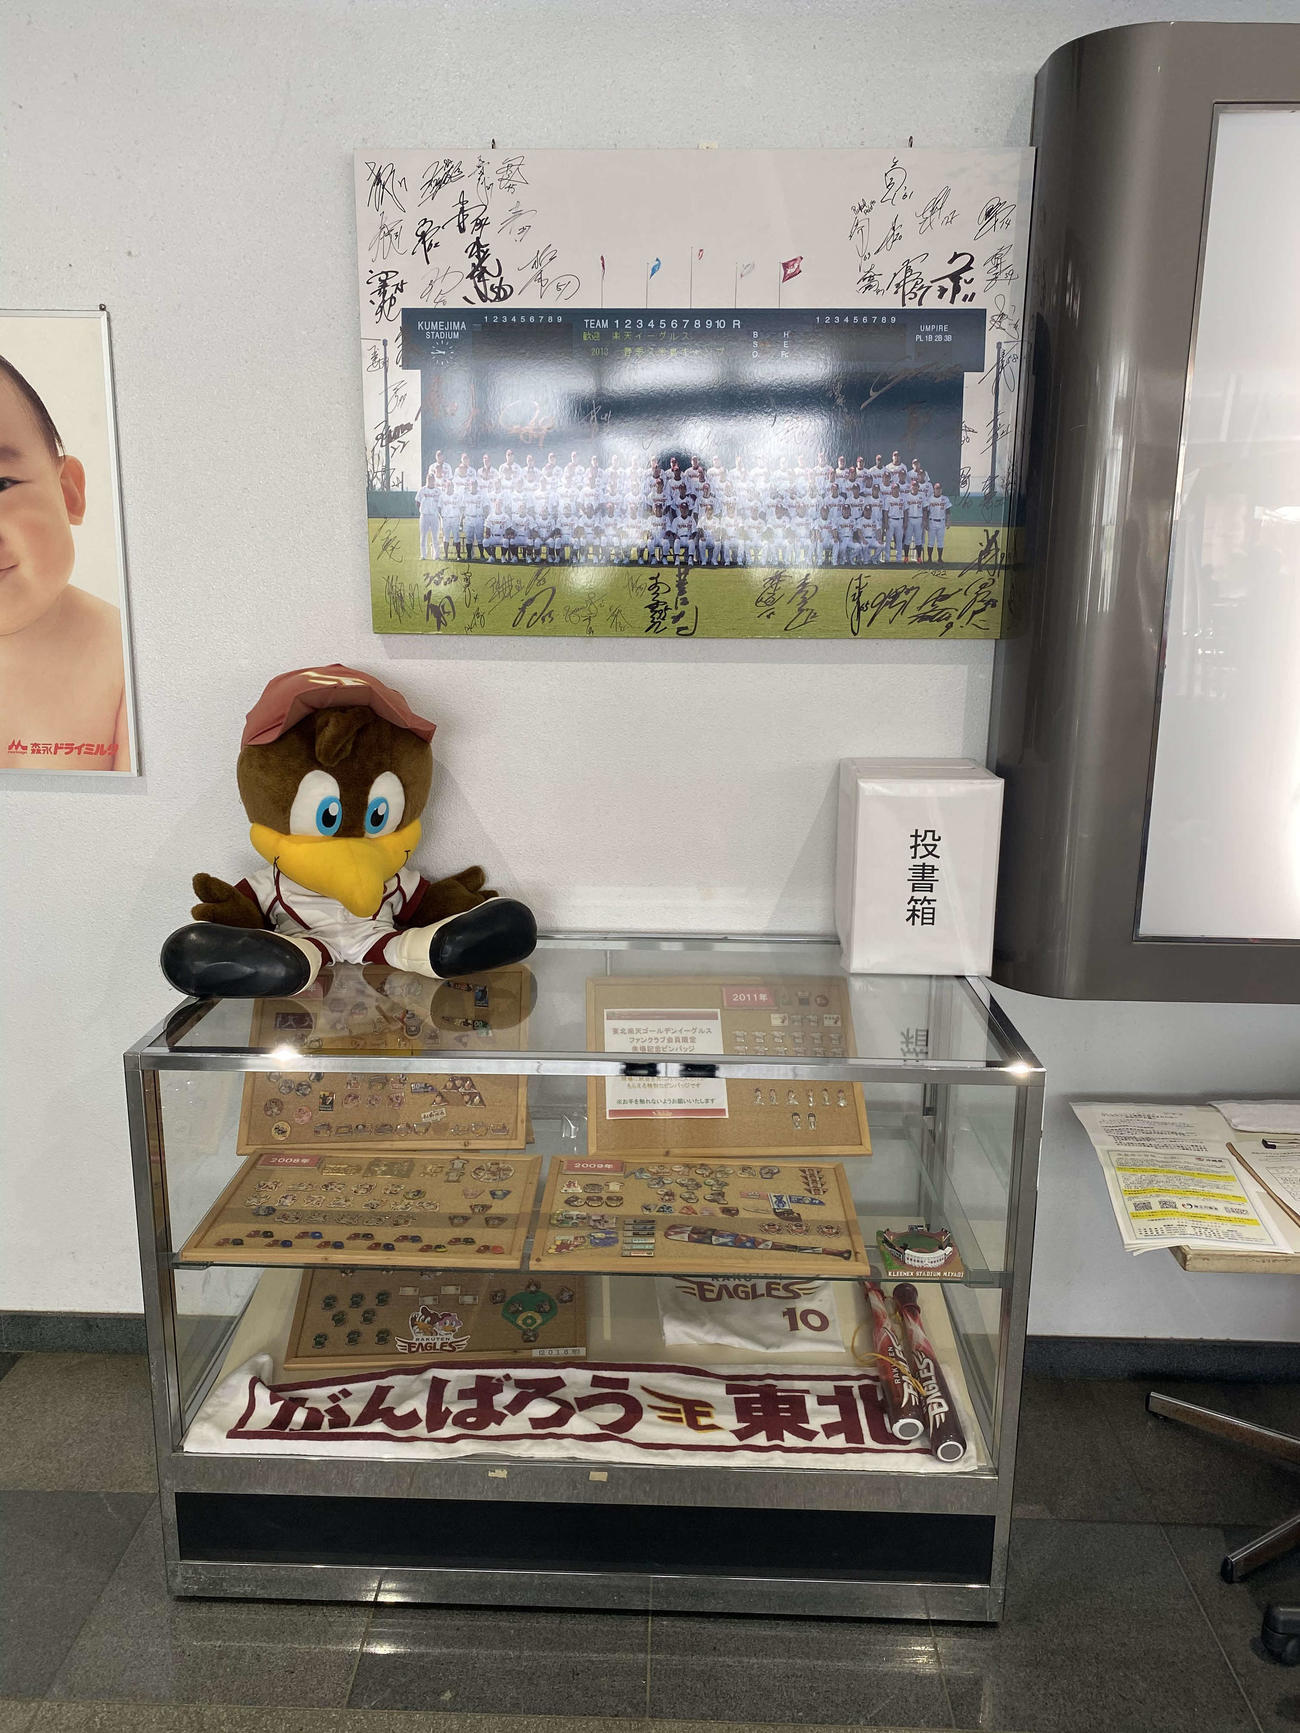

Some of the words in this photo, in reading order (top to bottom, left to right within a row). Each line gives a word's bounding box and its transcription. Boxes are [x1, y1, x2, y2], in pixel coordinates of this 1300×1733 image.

[417, 321, 467, 331] KUMEJIMA
[584, 319, 609, 329] TEAM
[714, 319, 726, 329] 10
[732, 319, 741, 329] R
[920, 324, 949, 332] UMPIRE
[425, 331, 460, 340] STADIUM
[783, 331, 789, 339] H
[915, 334, 924, 342] PL
[752, 340, 758, 348] S
[783, 340, 789, 348] E
[30, 742, 120, 756] 森永ドライミルク
[905, 828, 942, 927] 投書箱
[732, 993, 768, 1001] 2011年
[628, 1036, 697, 1044] ファンクラブ会員限定
[888, 1270, 914, 1278] KLEENEX
[693, 1280, 804, 1303] EAGLES
[782, 1306, 830, 1332] 10
[406, 1341, 458, 1353] EAGLES
[887, 1346, 901, 1385] RAKEN
[915, 1355, 949, 1420] EAGLES
[264, 1371, 644, 1436] がんばろう
[725, 1382, 912, 1446] 東北
